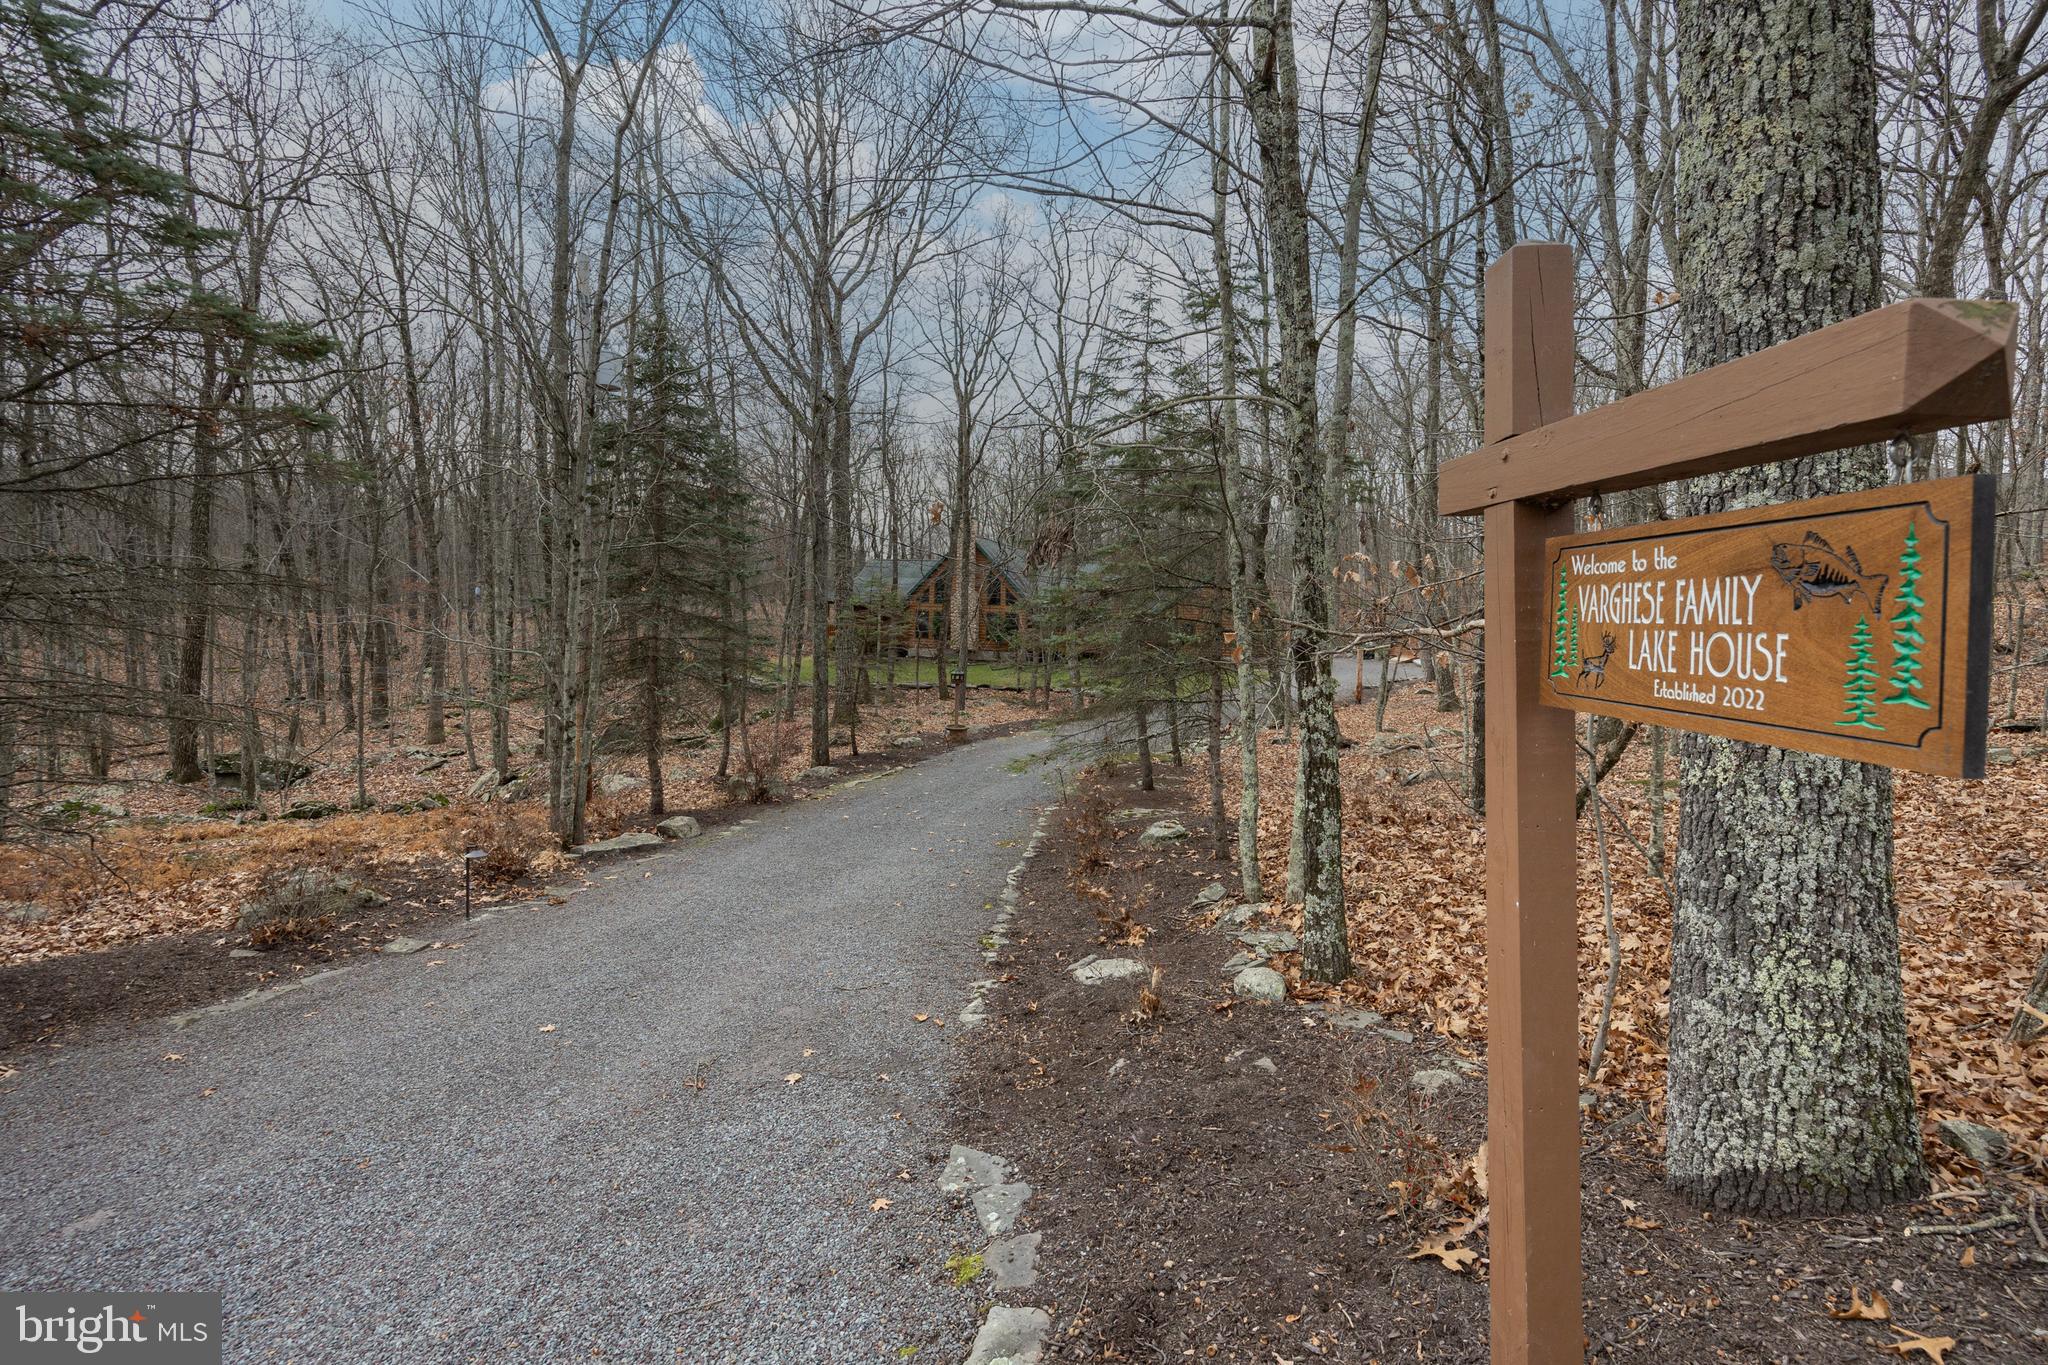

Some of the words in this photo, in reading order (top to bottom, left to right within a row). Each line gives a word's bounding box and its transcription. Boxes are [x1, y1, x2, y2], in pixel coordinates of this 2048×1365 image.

[1571, 552, 1626, 576] Welcome
[1632, 549, 1647, 571] to
[1654, 546, 1678, 570] the
[1578, 579, 1666, 625] VARGHESE
[1675, 573, 1763, 626] FAMILY
[1628, 629, 1678, 673] LAKE
[1689, 631, 1789, 684] HOUSE
[1653, 679, 1716, 705] Established
[1723, 685, 1765, 711] 2022
